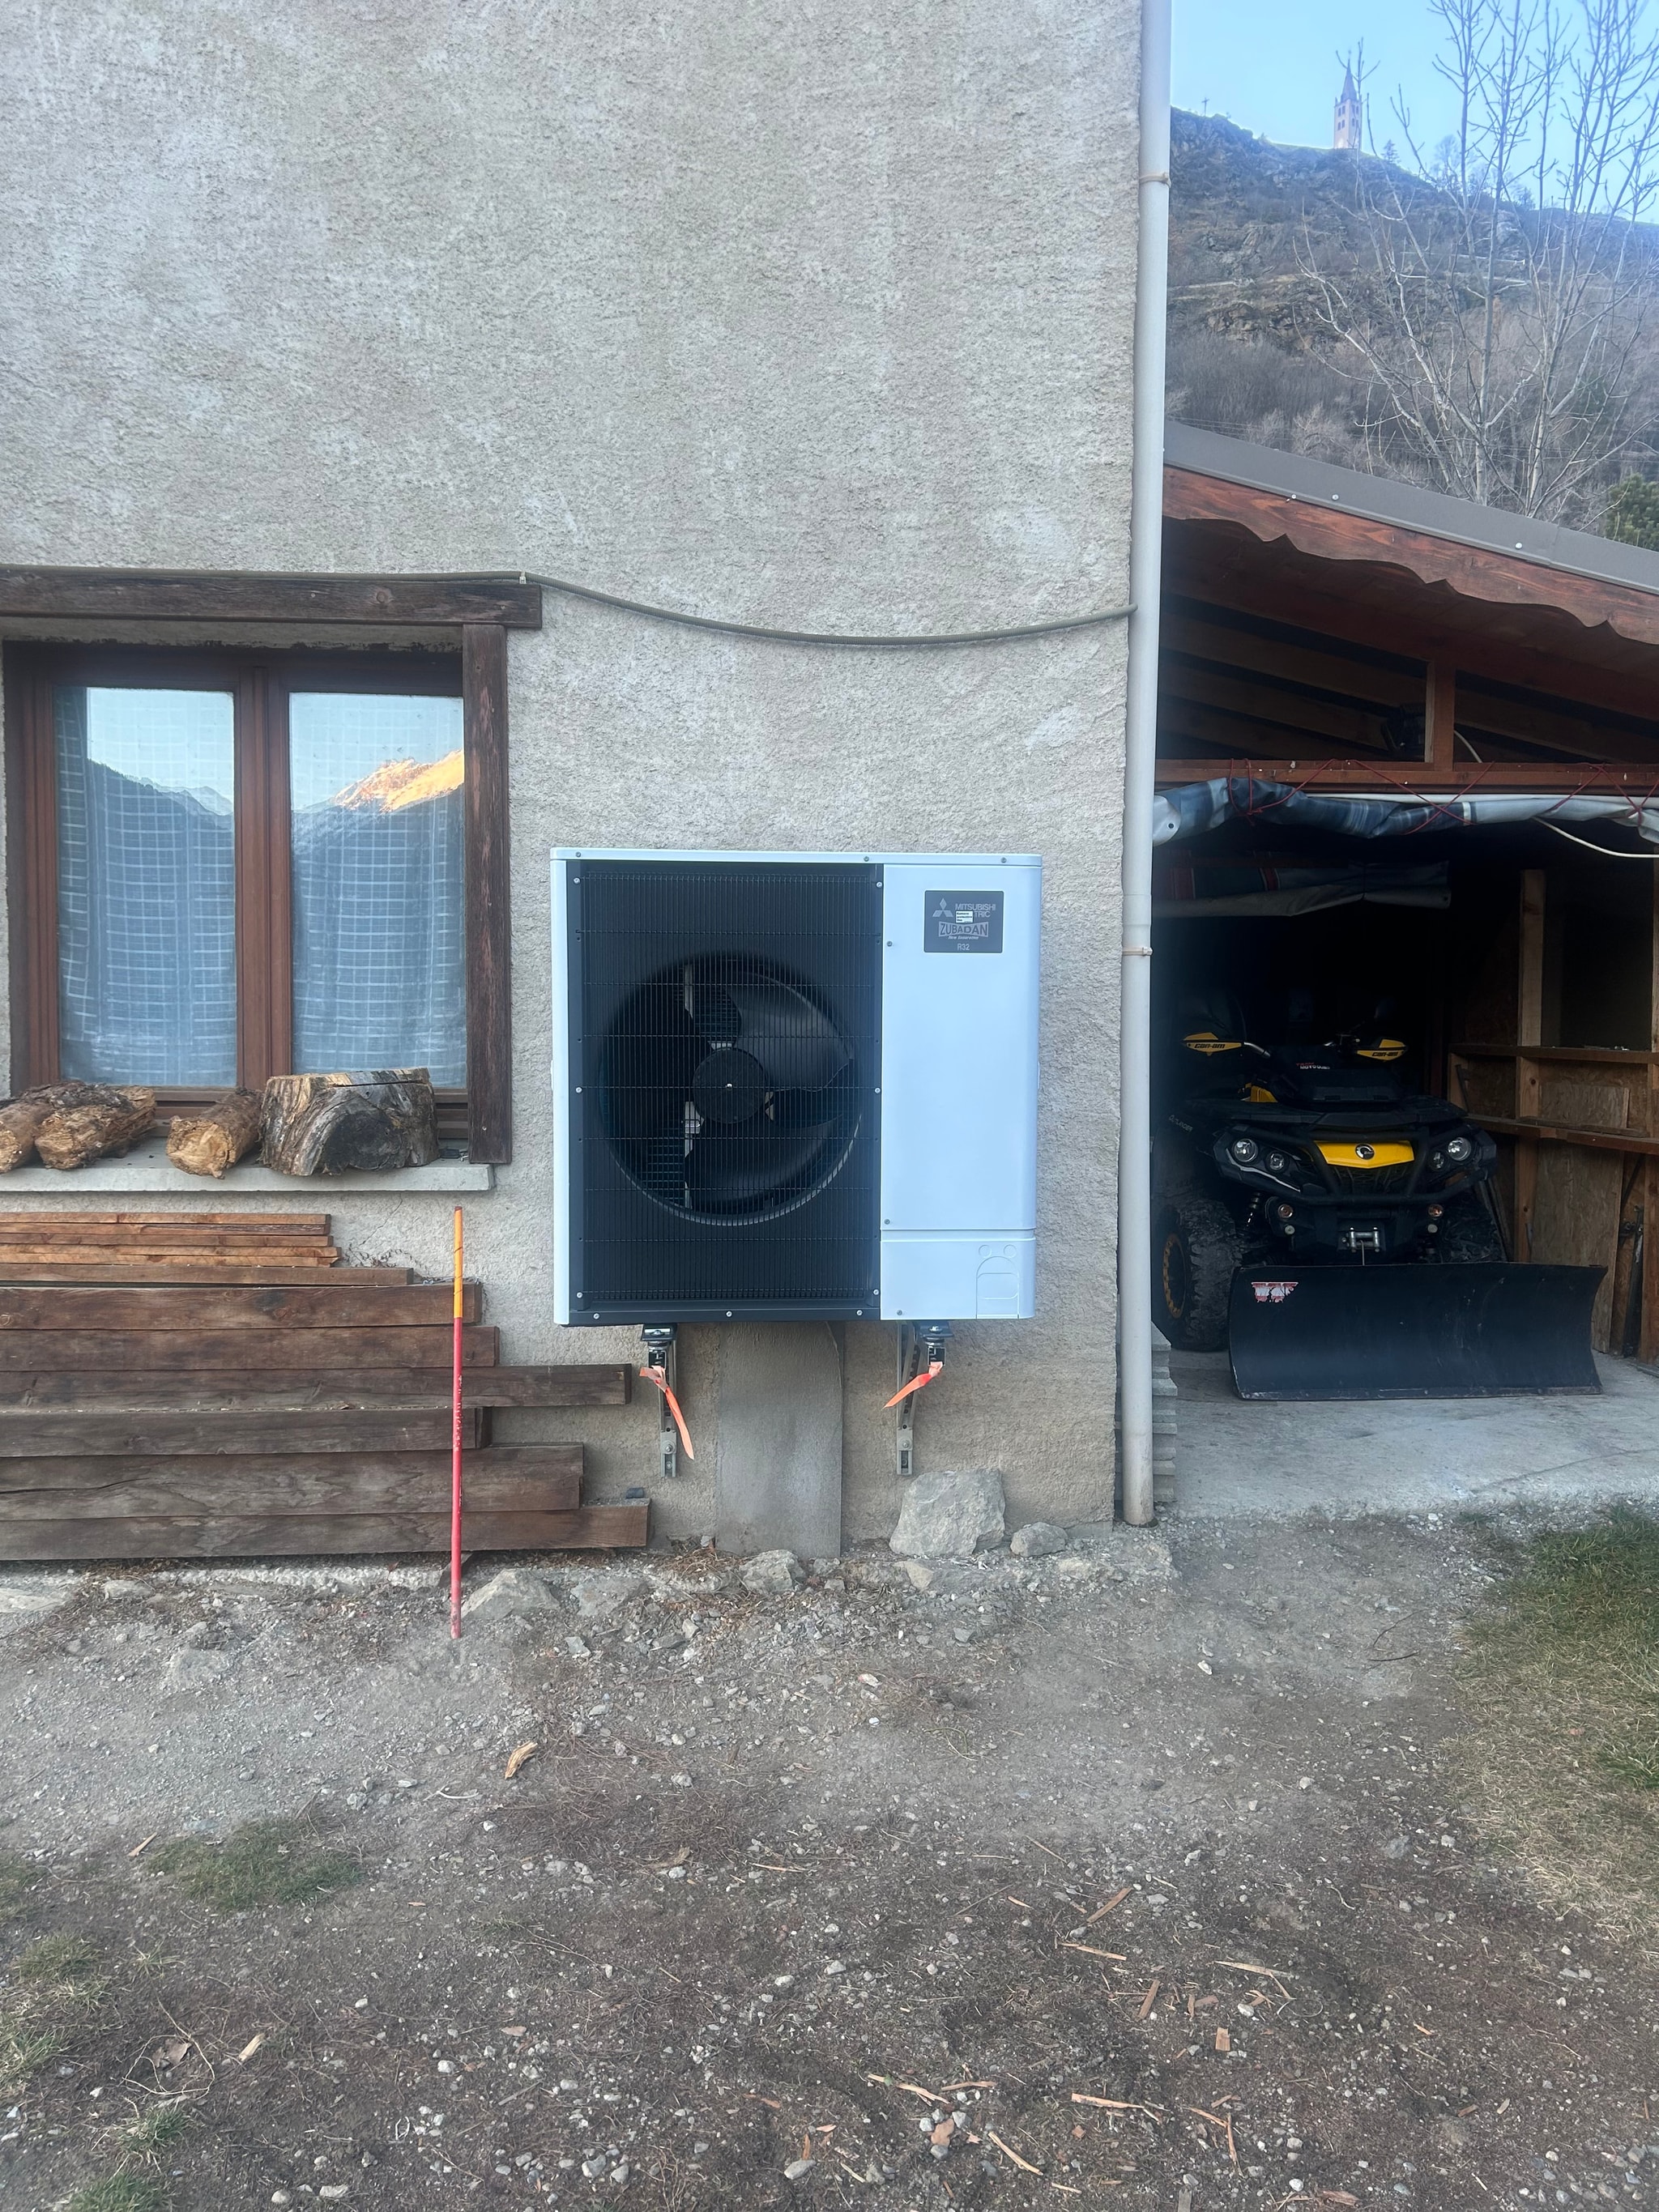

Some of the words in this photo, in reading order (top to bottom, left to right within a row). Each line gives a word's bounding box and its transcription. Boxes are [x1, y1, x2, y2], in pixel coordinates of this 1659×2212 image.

[955, 903, 996, 911] MITSUBISHI
[973, 910, 991, 918] TRIC
[940, 923, 987, 936] ZUBADAN
[957, 943, 970, 951] R32
